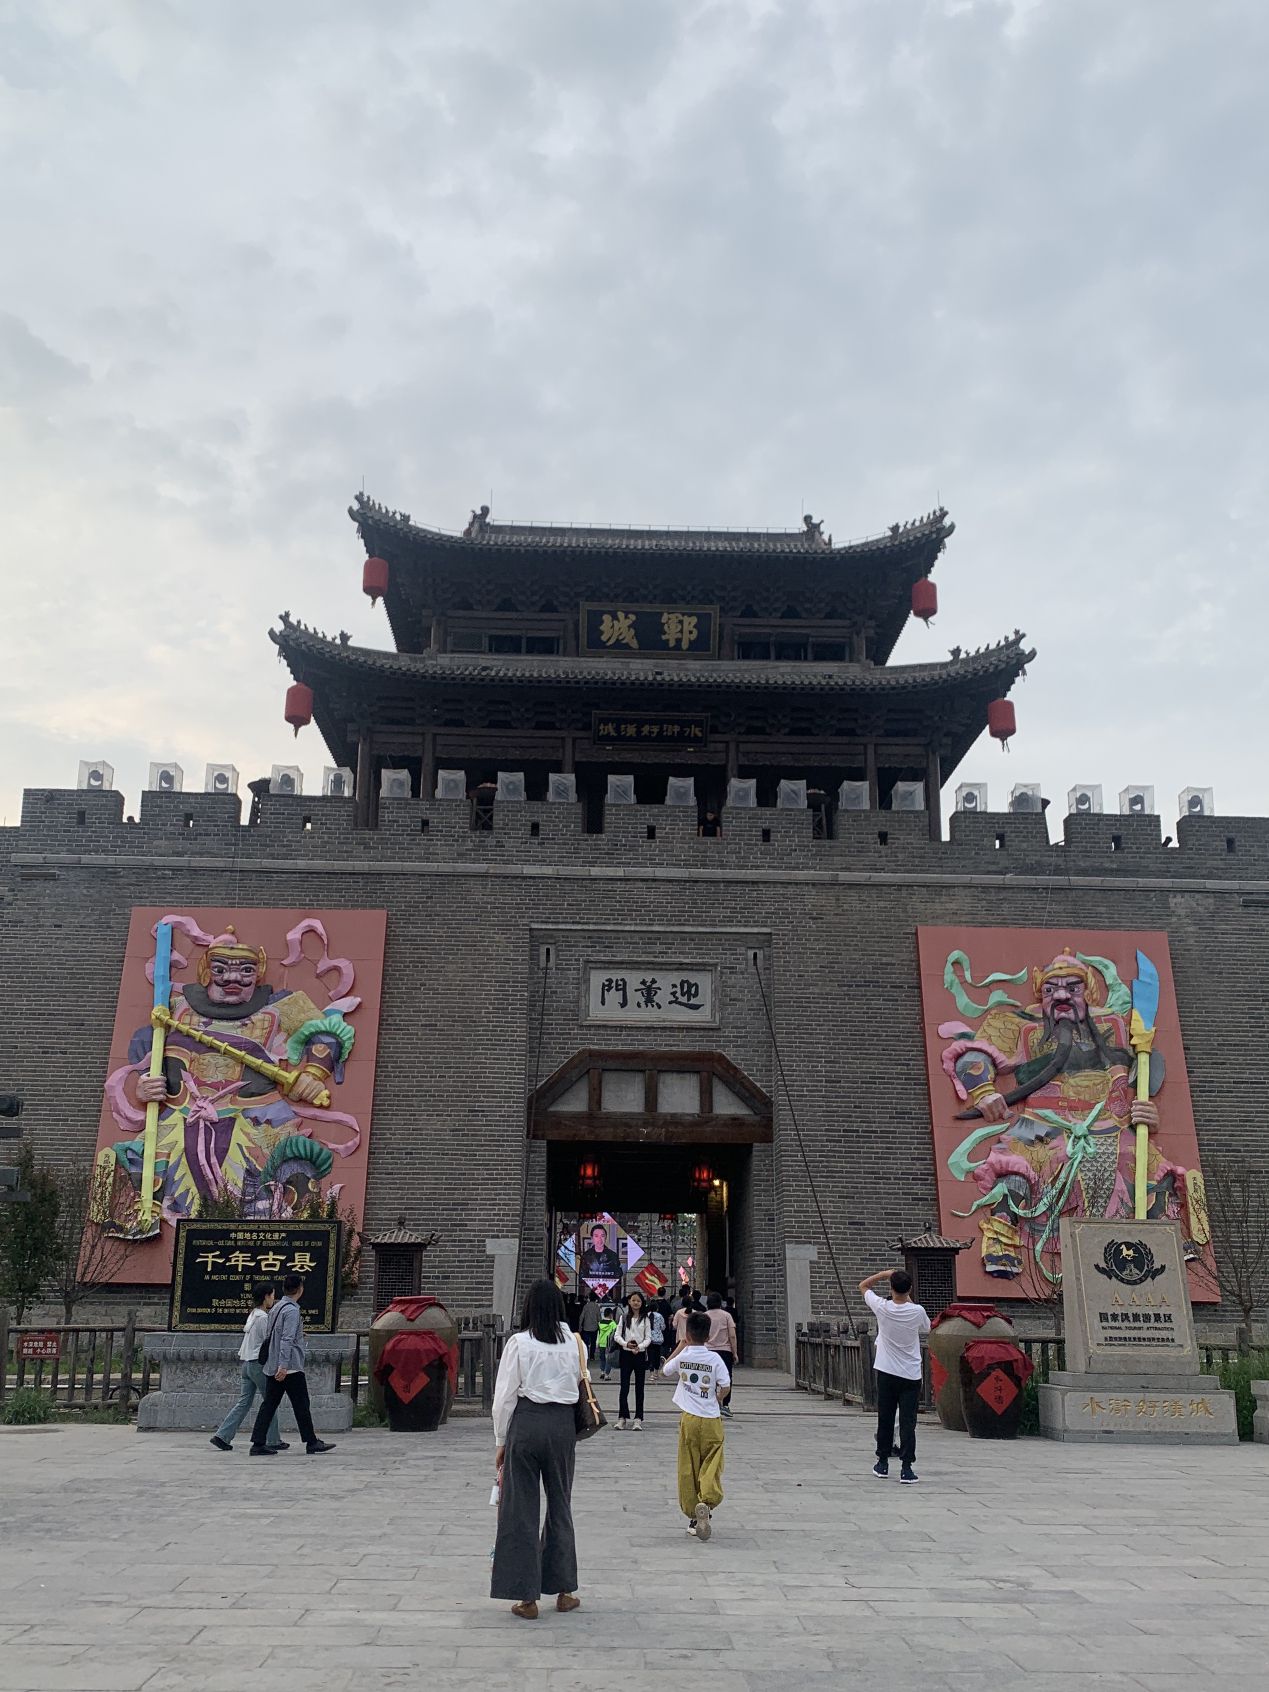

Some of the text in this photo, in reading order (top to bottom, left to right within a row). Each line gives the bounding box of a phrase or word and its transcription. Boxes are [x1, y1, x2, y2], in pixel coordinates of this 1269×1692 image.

[230, 1232, 287, 1240] 中国地名文化遗产
[195, 1250, 317, 1272] 千年古县
[212, 1299, 254, 1307] 联合国地名专
